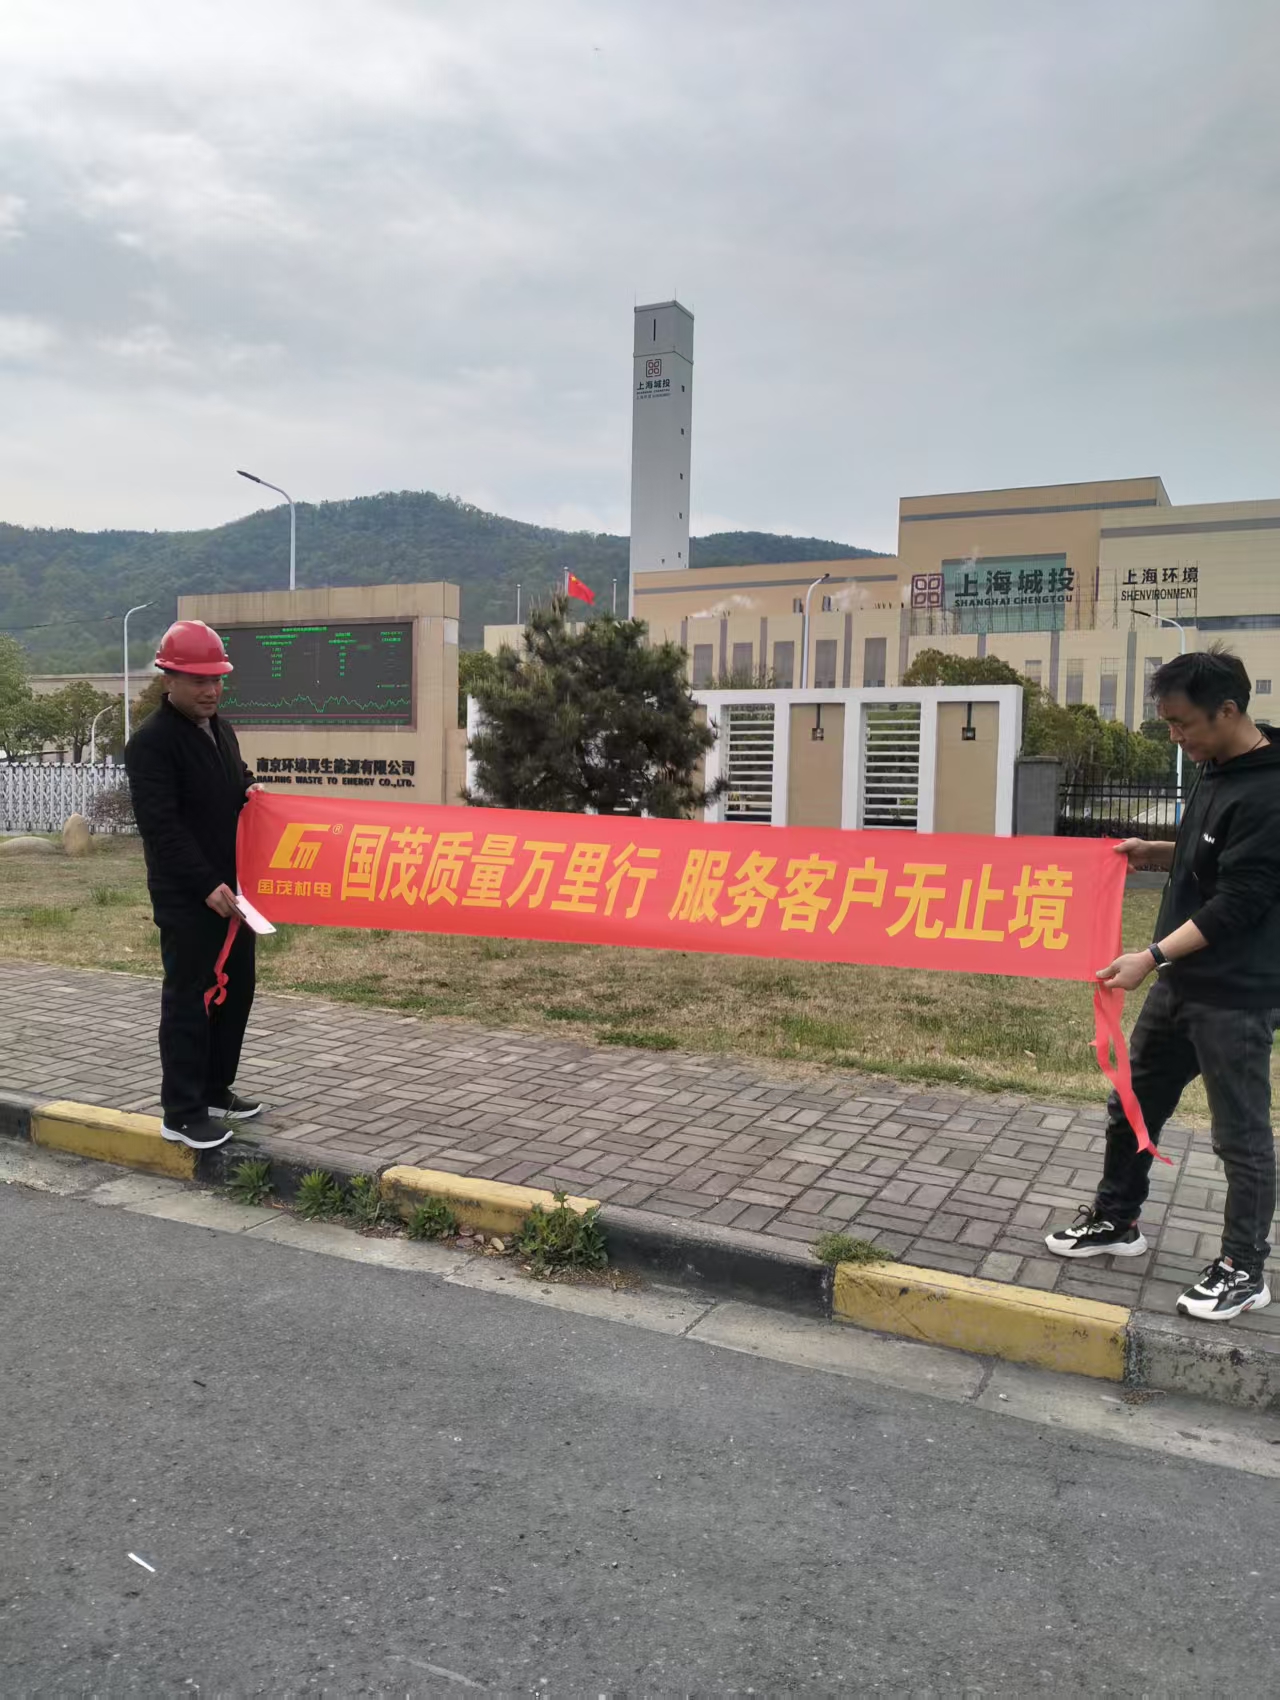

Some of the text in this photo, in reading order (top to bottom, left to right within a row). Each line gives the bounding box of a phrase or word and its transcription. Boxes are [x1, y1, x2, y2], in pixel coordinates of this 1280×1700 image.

[636, 379, 671, 390] 上海城投
[955, 567, 1074, 597] 上海城投
[1122, 567, 1199, 585] 上海环境
[955, 594, 1073, 607] SHANGHAI CHENGTOU
[1121, 587, 1198, 601] SHENVIRONMENT
[256, 757, 416, 776] 南京环境再生能源有限公司
[295, 776, 323, 785] WASTE
[327, 777, 338, 785] TO
[342, 777, 375, 786] ENERGY
[257, 879, 332, 898] 国茂机电
[340, 824, 1074, 950] 国茂质量万里行 服务客户无止境
